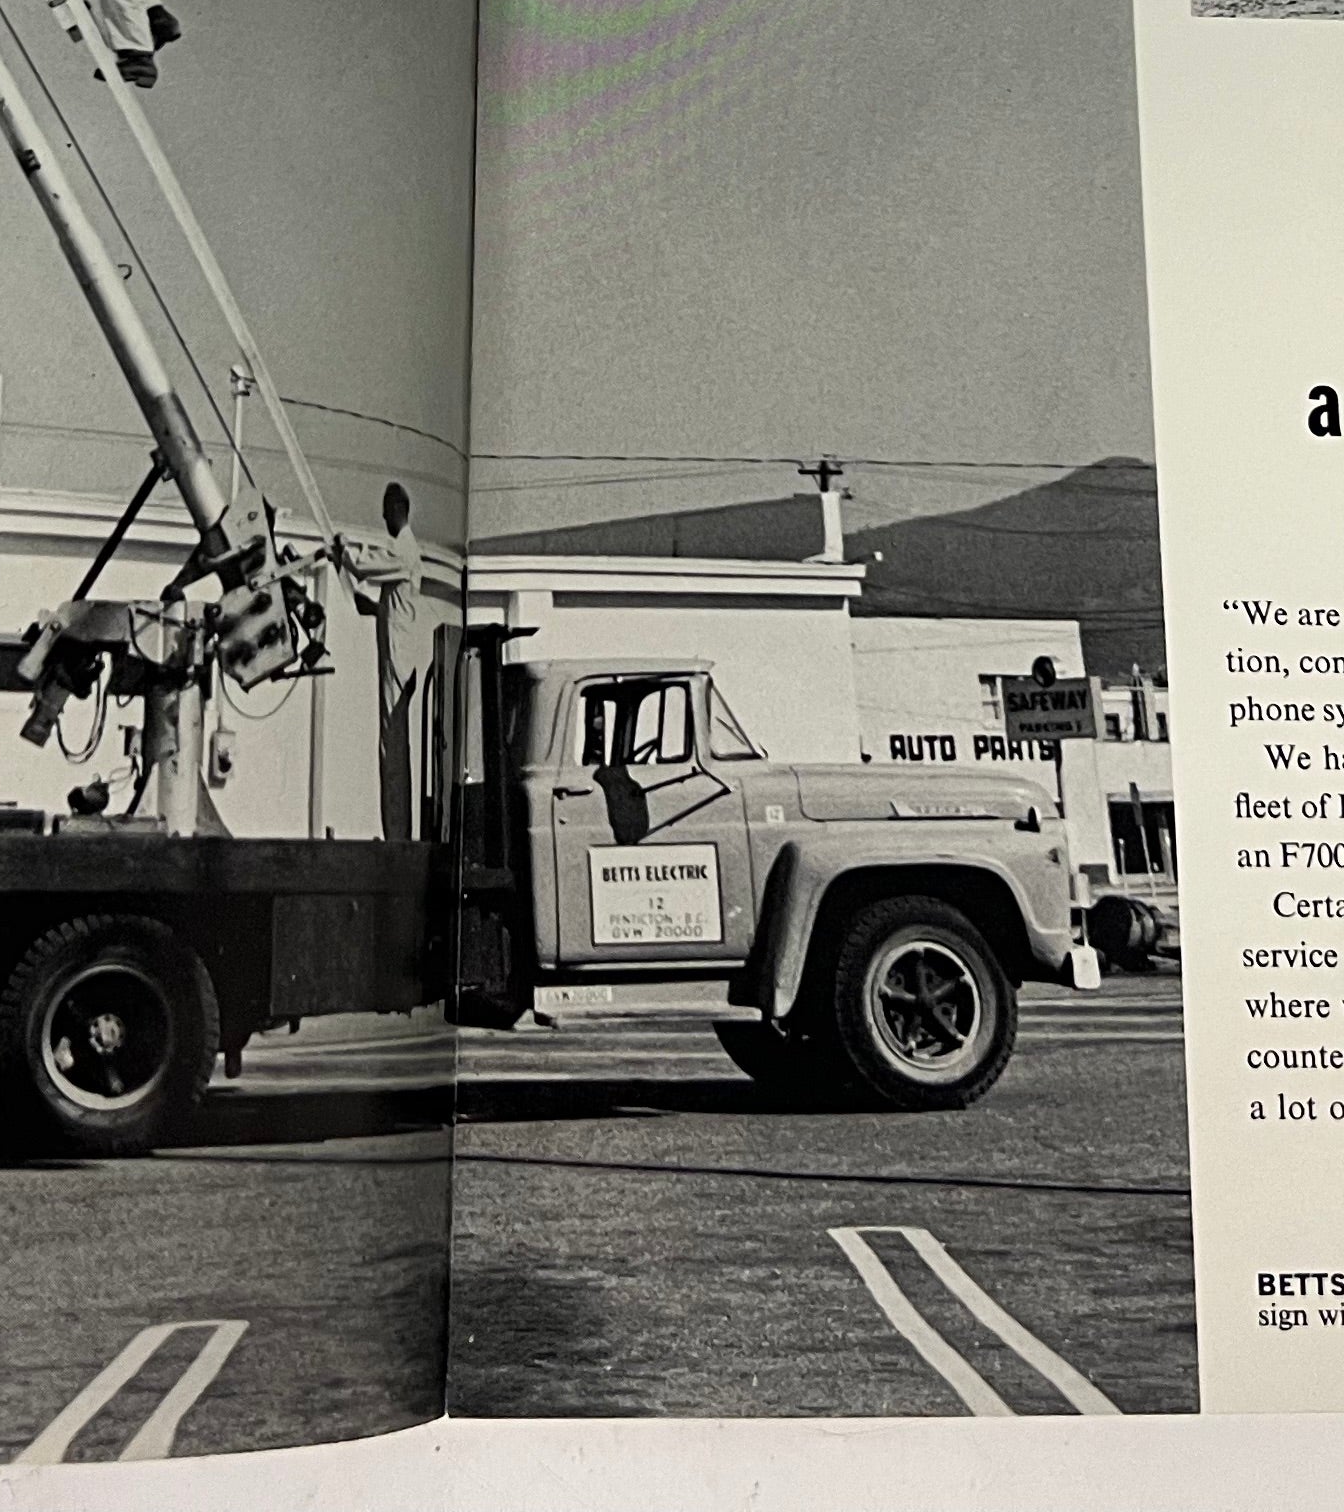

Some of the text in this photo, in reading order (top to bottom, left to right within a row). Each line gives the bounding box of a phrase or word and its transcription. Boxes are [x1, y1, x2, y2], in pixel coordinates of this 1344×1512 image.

[1307, 384, 1343, 438] a
[1297, 608, 1341, 627] are
[1225, 647, 1290, 679] tion,
[1007, 689, 1088, 712] SAFEWAY
[1229, 695, 1316, 728] phone
[890, 734, 1056, 761] AUTO PARTS
[1263, 743, 1312, 771] We
[1233, 791, 1293, 820] fleet
[1301, 792, 1332, 820] of
[1237, 849, 1271, 869] an
[602, 864, 709, 883] BETTS ELECTRIC
[1250, 1100, 1267, 1121] a
[1277, 1092, 1318, 1121] lot
[1258, 1302, 1309, 1332] sign
